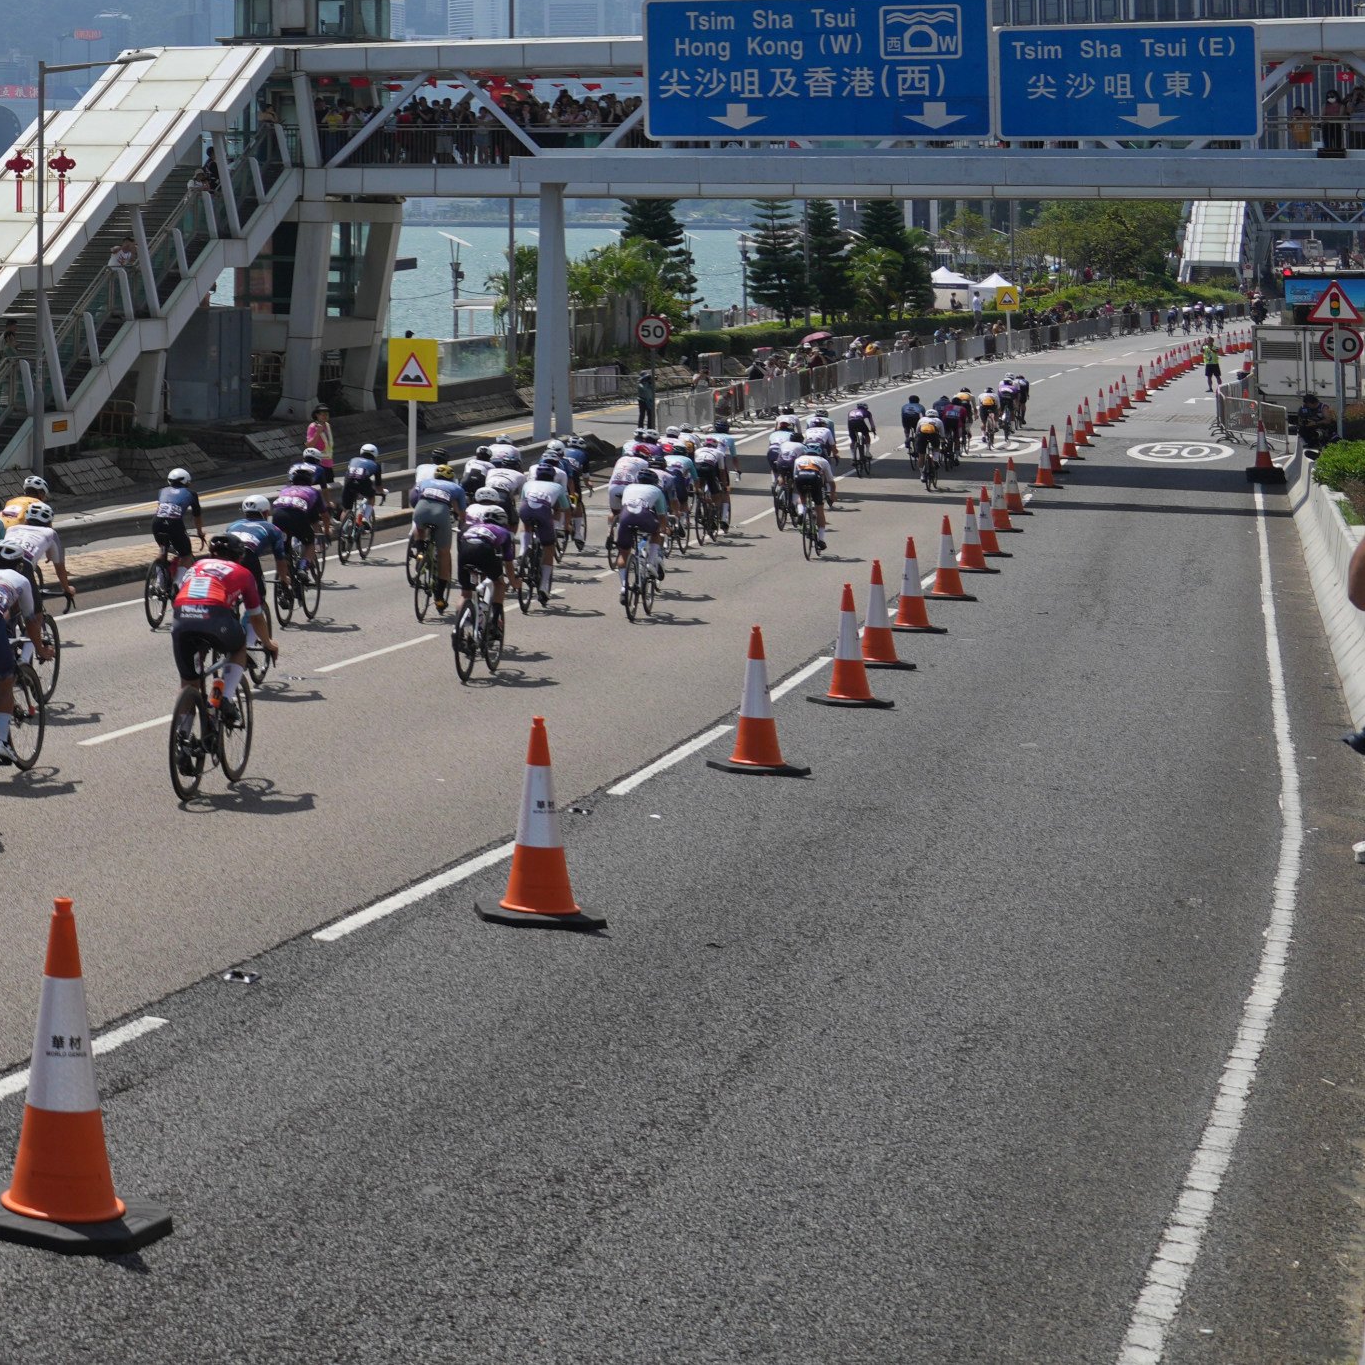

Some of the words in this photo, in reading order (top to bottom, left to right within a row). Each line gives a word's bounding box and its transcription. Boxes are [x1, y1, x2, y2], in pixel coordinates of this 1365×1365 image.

[686, 11, 735, 31] Tsim
[752, 9, 794, 30] Sha
[811, 7, 856, 28] Tsui
[675, 37, 731, 61] Hong
[747, 36, 804, 59] Kong
[819, 33, 862, 54] (W)
[887, 36, 901, 52] 西
[939, 35, 957, 52] W
[1011, 41, 1062, 59] Tsim
[1080, 39, 1122, 59] Sha
[1140, 38, 1187, 57] Tsui
[1199, 36, 1236, 57] (E)
[659, 64, 945, 99] 尖沙咀及香港(西)
[1027, 71, 1212, 99] 尖沙咀(東)
[641, 324, 665, 338] 50
[1326, 336, 1357, 353] 50
[1148, 445, 1212, 458] 50
